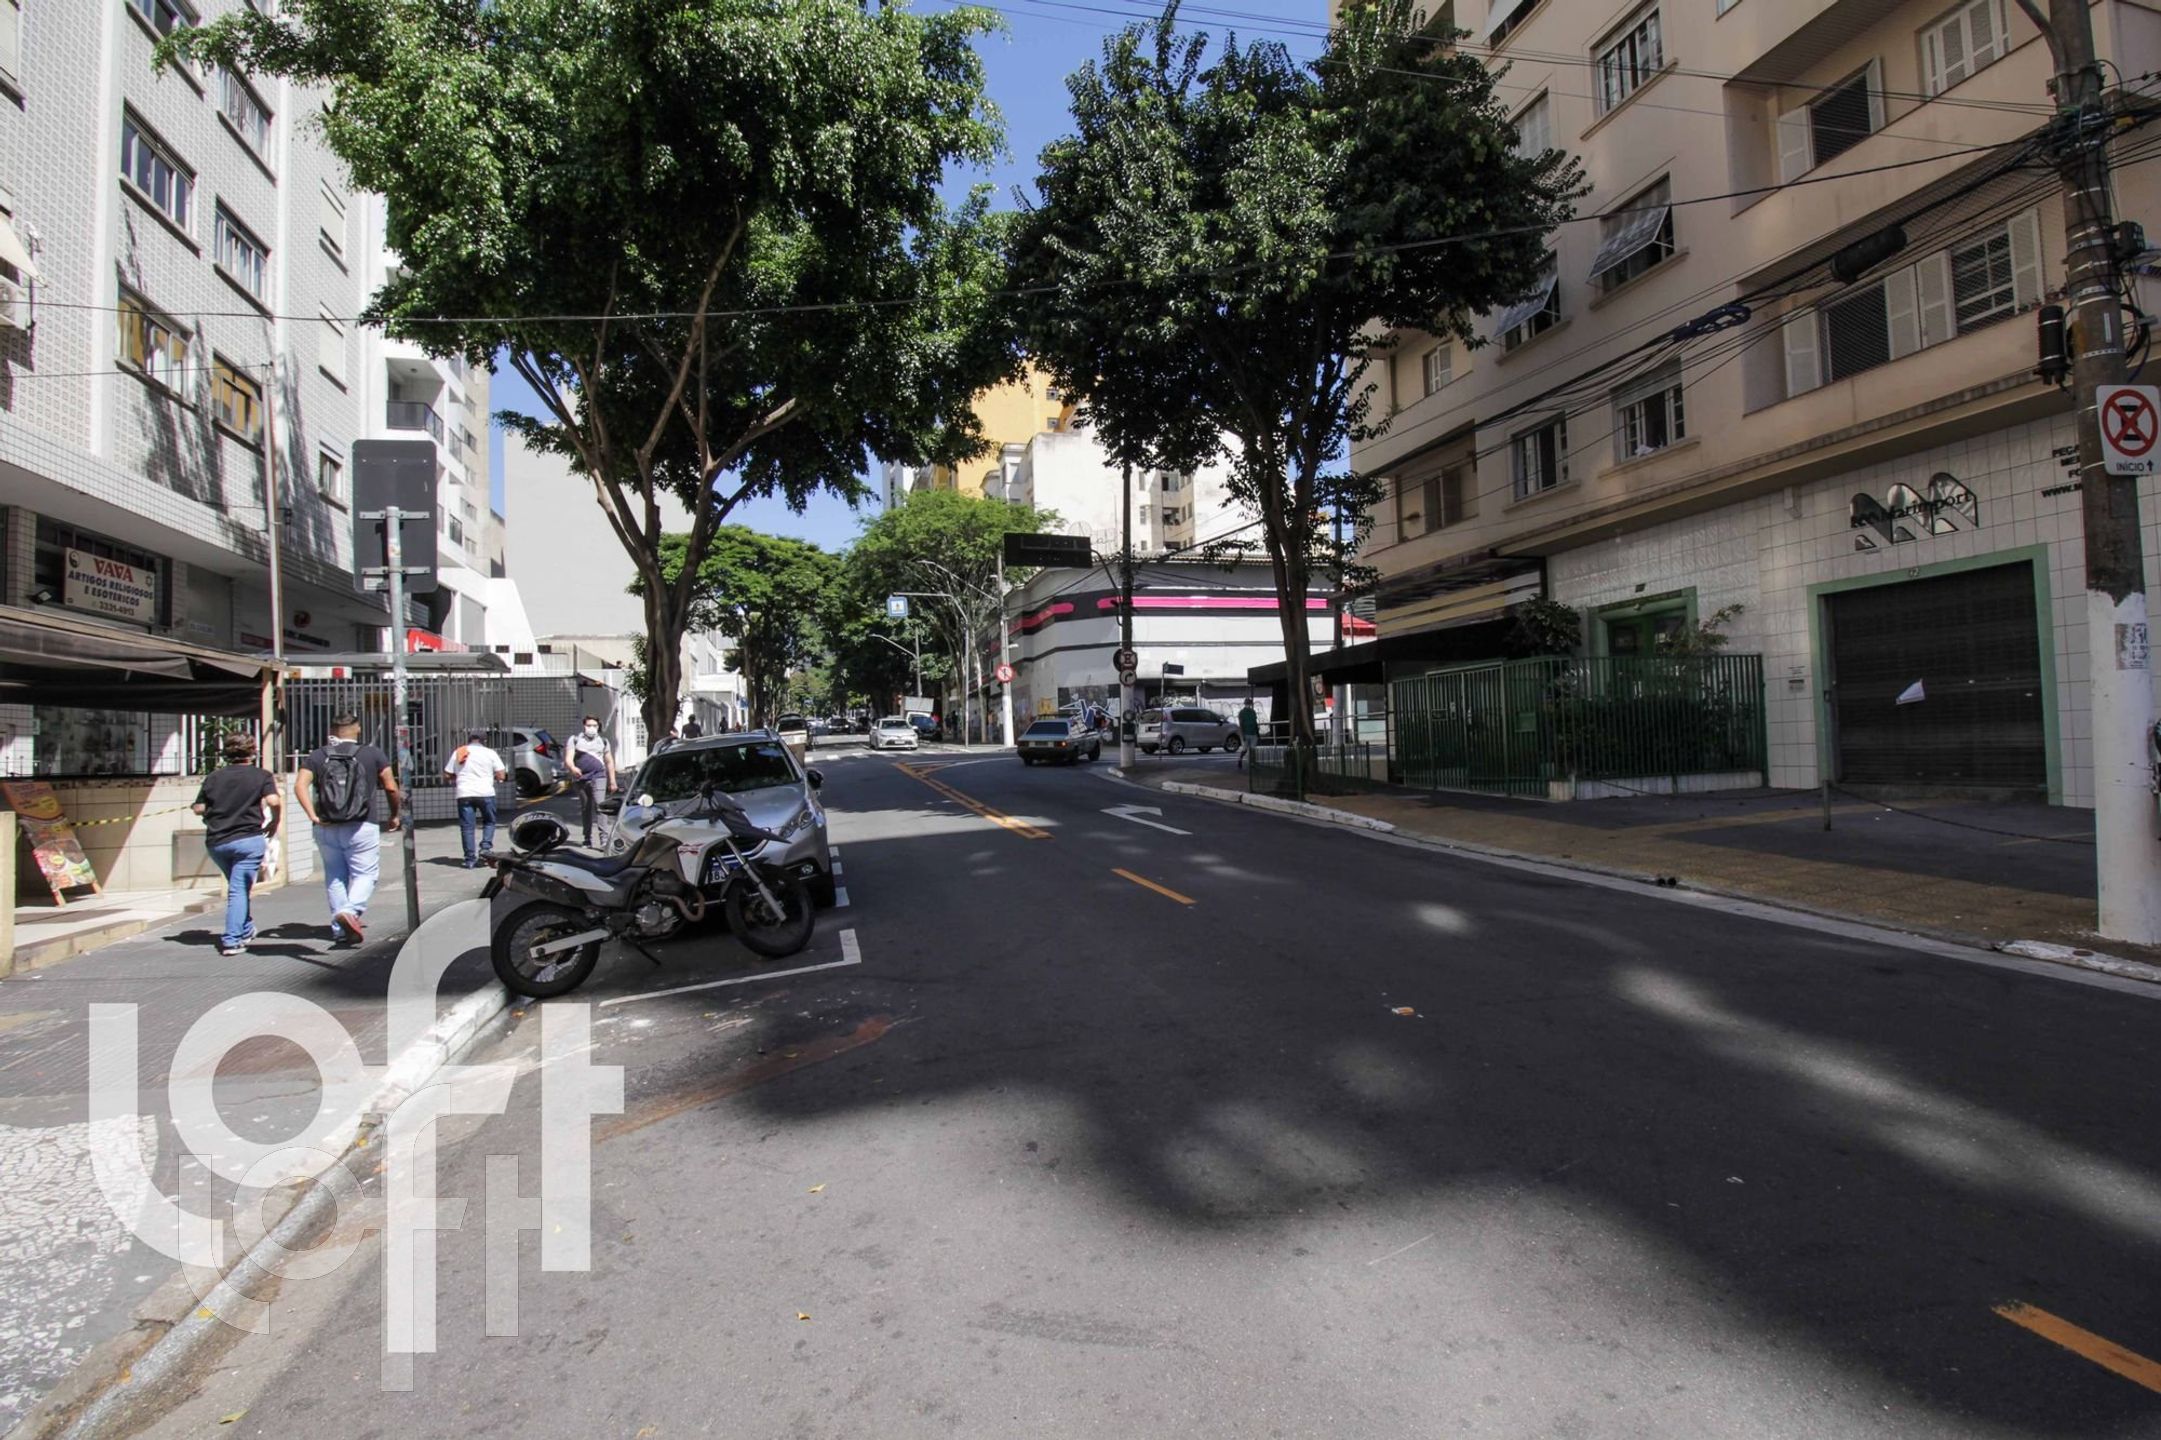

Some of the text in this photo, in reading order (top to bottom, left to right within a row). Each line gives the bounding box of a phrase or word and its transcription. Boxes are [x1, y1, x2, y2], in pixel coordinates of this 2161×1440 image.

[2116, 462, 2145, 472] INÍCIO
[68, 570, 153, 600] ARTIGOS RELIGIOSOS
[84, 585, 89, 595] E
